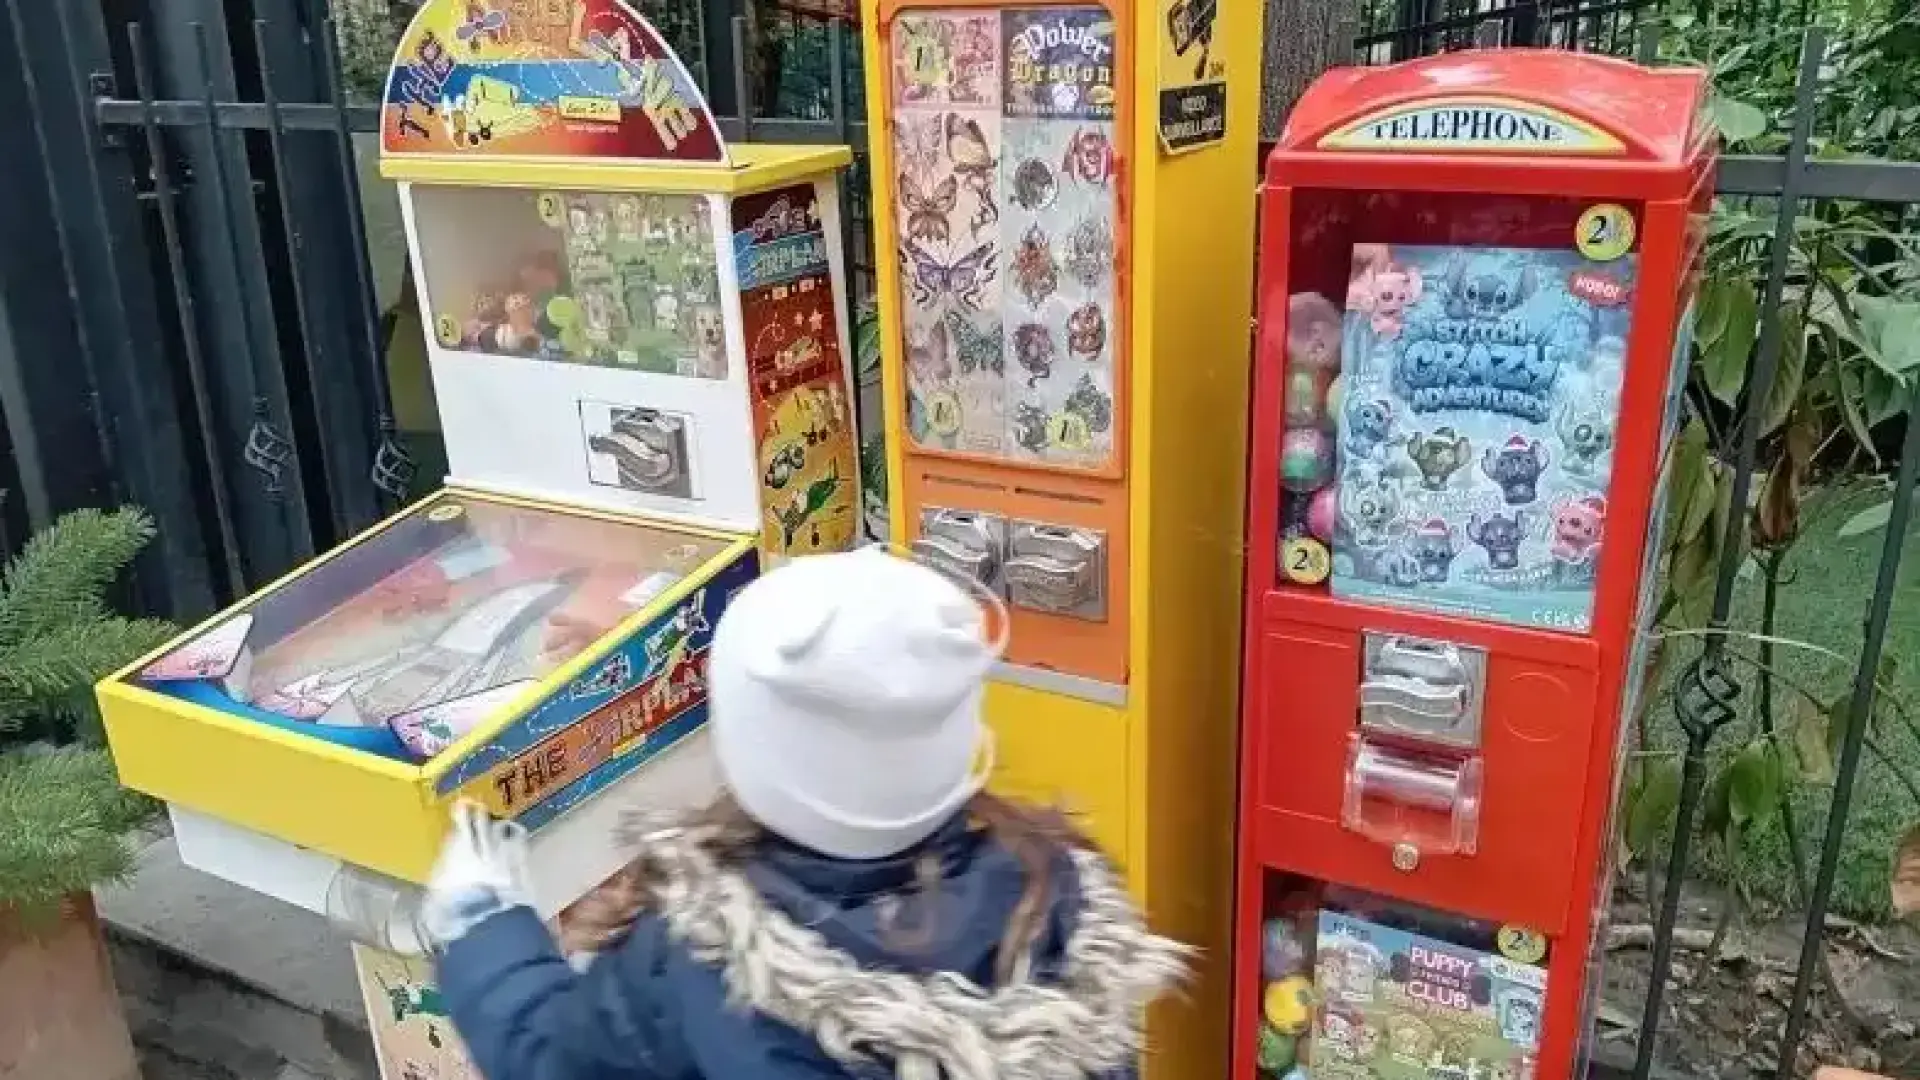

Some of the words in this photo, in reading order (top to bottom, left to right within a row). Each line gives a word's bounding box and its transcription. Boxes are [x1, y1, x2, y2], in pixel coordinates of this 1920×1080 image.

[1012, 18, 1111, 61] Power
[1010, 57, 1110, 83] Dragon
[1371, 109, 1563, 141] TELEPHONE
[1587, 215, 1607, 244] 2
[1436, 319, 1528, 346] STITCH
[1403, 341, 1560, 394] CRAZY
[1291, 546, 1308, 571] 2
[496, 738, 567, 805] THE
[1411, 946, 1474, 979] PUPPY
[1409, 980, 1467, 1009] CLUB
